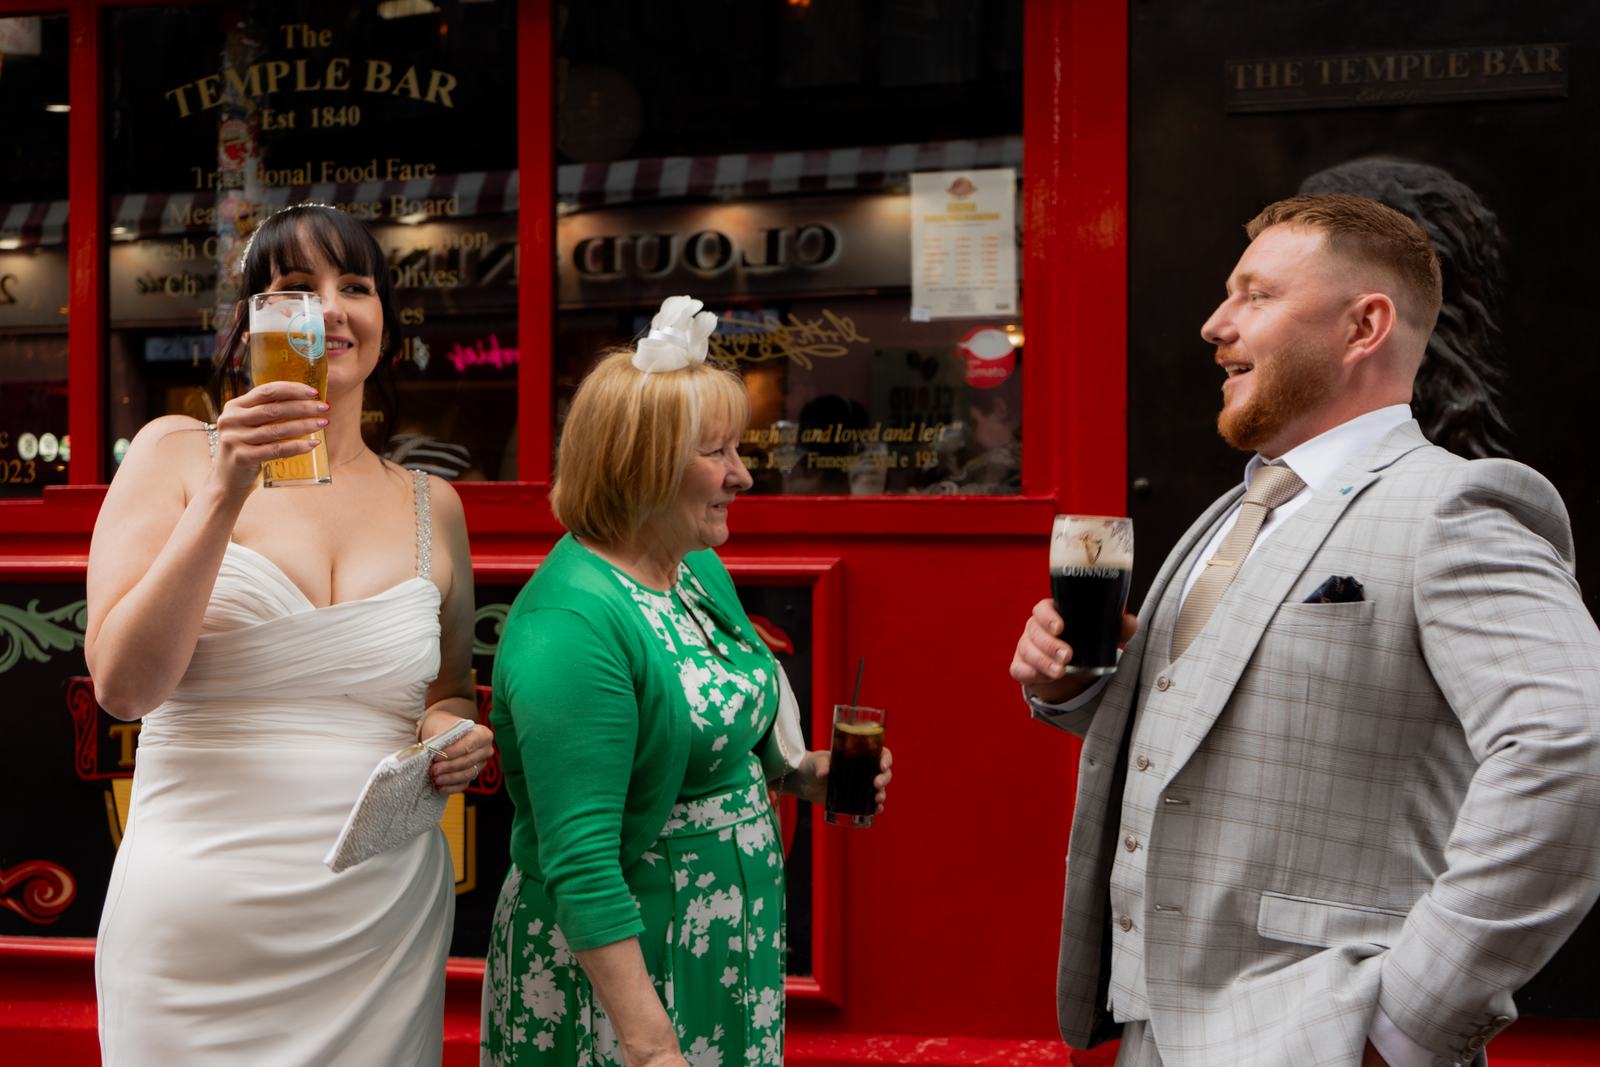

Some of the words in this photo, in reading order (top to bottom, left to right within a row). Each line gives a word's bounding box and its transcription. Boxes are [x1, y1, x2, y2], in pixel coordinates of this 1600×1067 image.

[279, 22, 335, 49] The
[1232, 62, 1304, 90] THE
[1315, 51, 1469, 85] TEMPLE
[1482, 45, 1564, 79] BAR
[164, 57, 352, 119] TEMPLE
[363, 58, 460, 109] BAR
[261, 109, 297, 131] Est
[309, 104, 362, 129] 1840
[320, 157, 378, 183] Food
[386, 156, 438, 181] Fare
[391, 193, 460, 217] Board
[801, 424, 833, 445] and
[834, 423, 881, 445] loved
[882, 422, 915, 444] and
